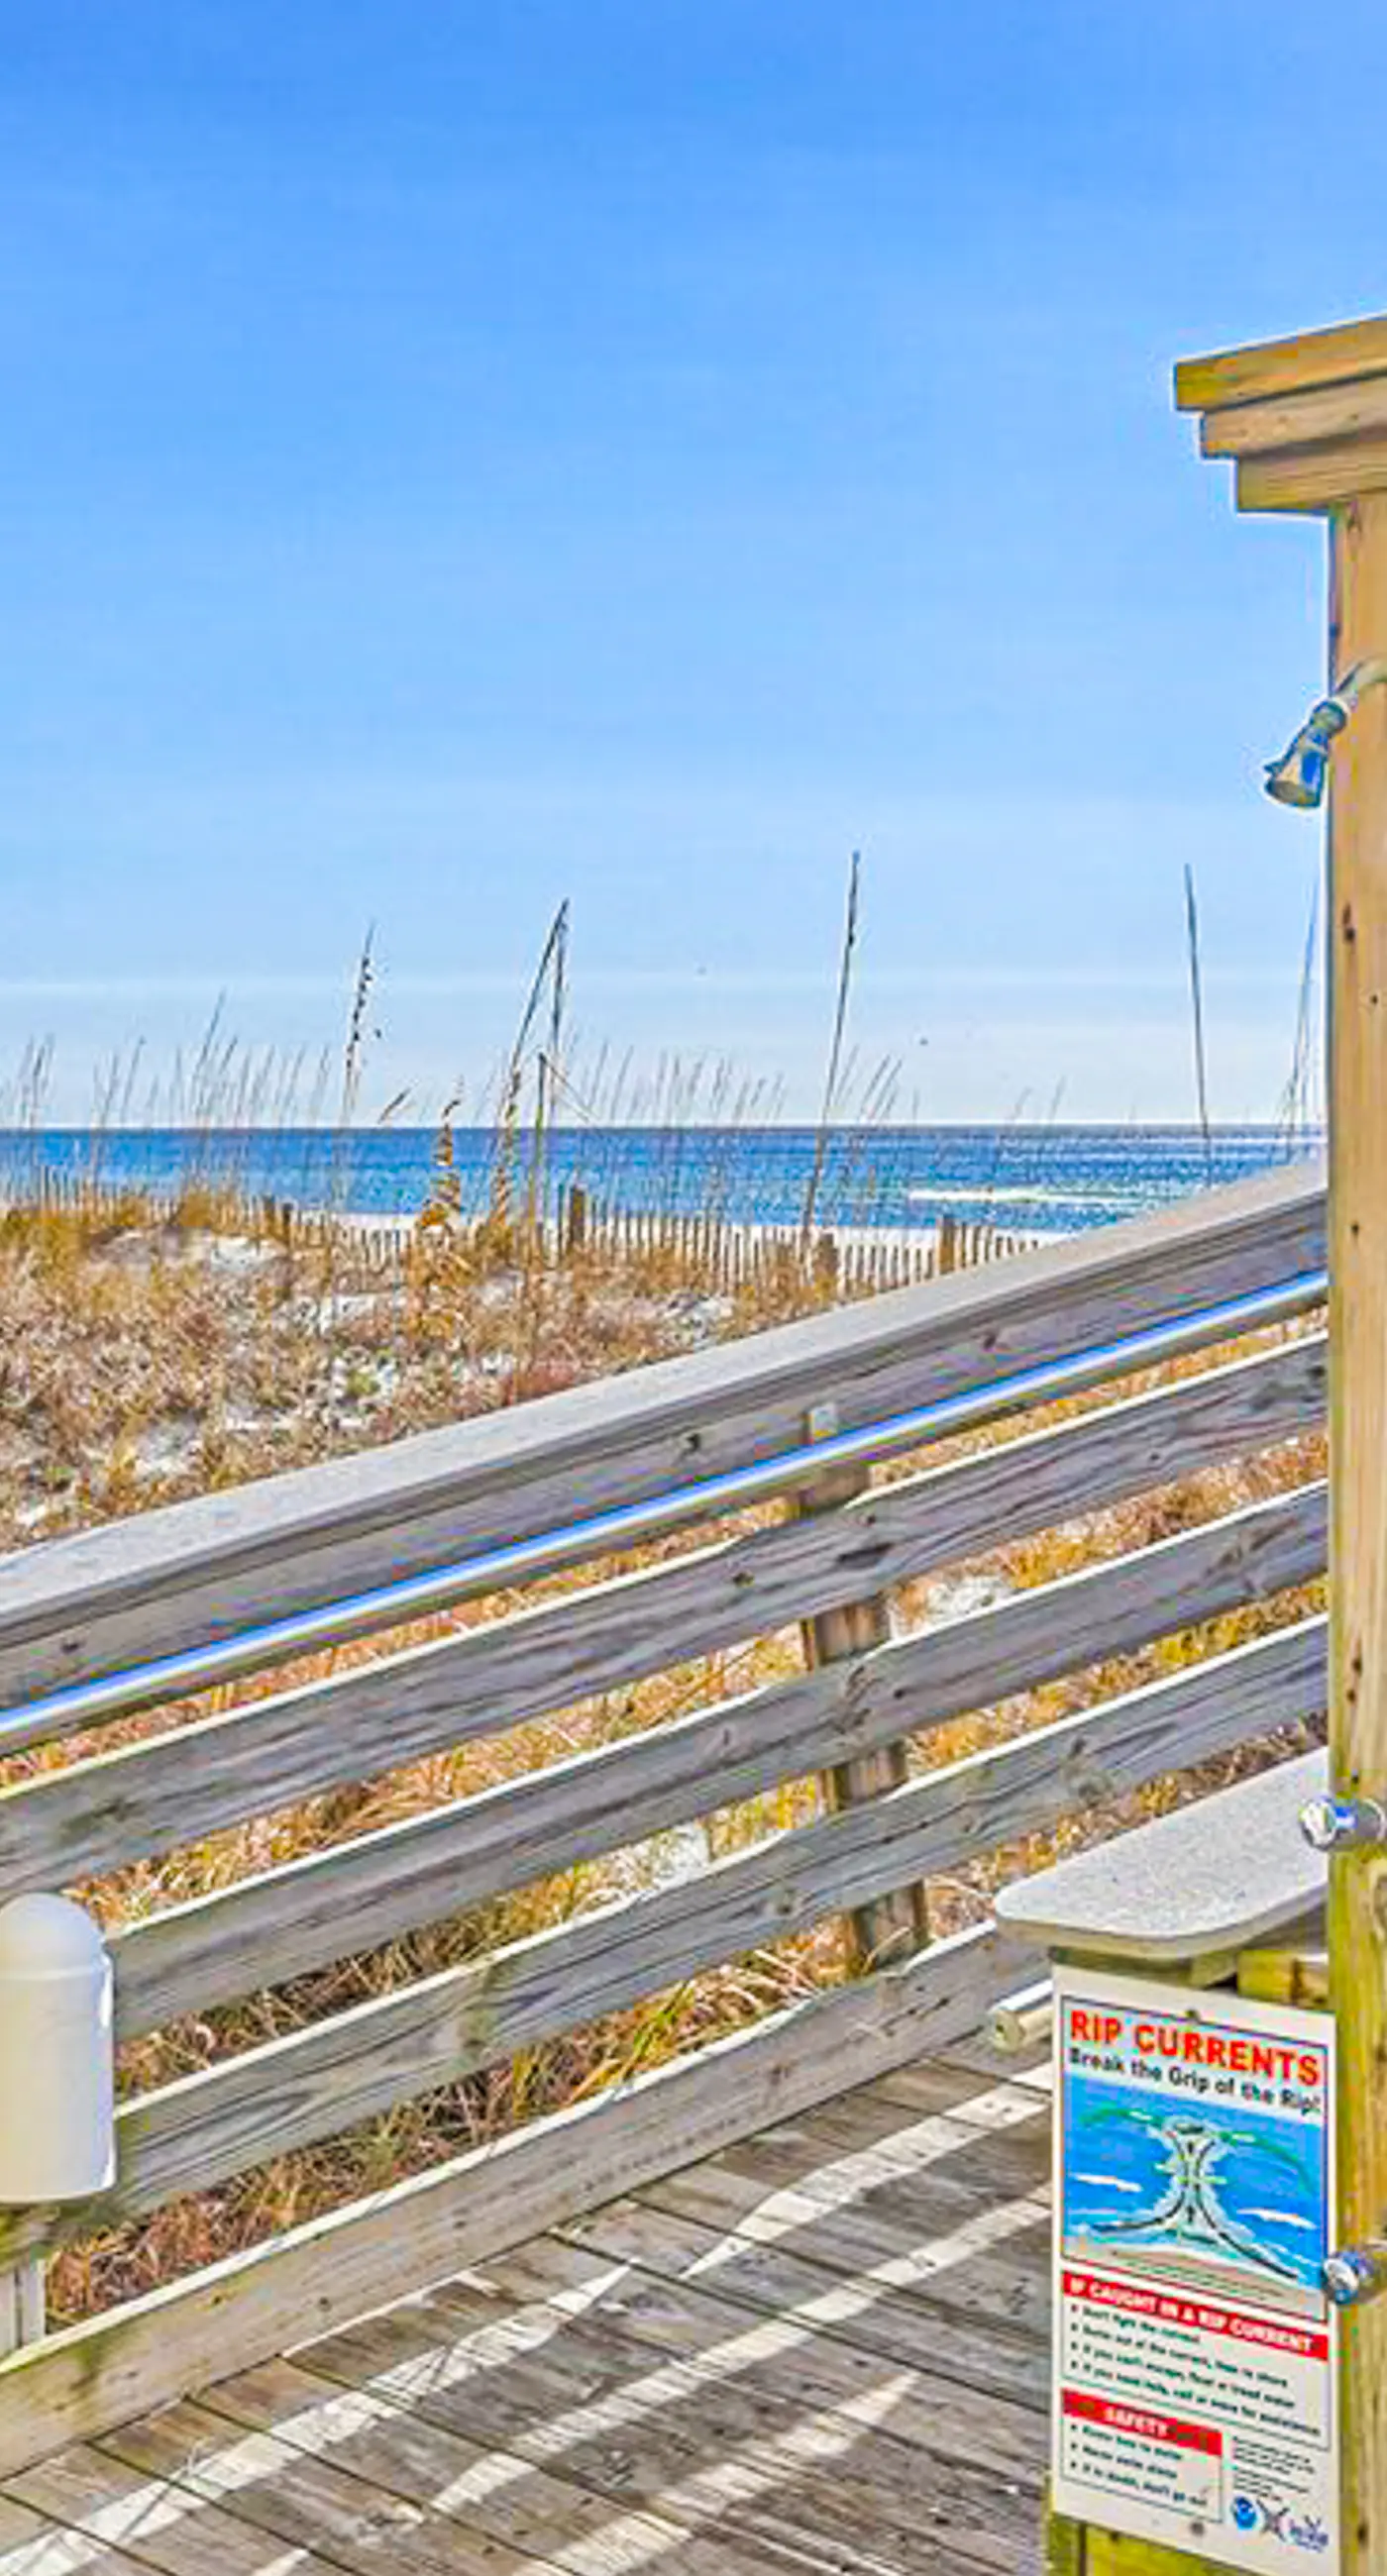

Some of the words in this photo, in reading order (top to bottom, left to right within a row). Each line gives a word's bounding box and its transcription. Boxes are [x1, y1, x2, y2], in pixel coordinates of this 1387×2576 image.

[1070, 2047, 1125, 2075] Break
[1131, 2056, 1162, 2081] the
[1169, 2065, 1210, 2093] Grip
[1215, 2077, 1234, 2096] of
[1240, 2080, 1275, 2105] the
[1071, 2009, 1120, 2044] RIP
[1134, 2023, 1320, 2086] CURRENTS
[1069, 2277, 1086, 2294] IF
[1089, 2281, 1156, 2313] CAUGHT
[1159, 2299, 1178, 2317] IN
[1182, 2304, 1195, 2322] A
[1198, 2310, 1227, 2328] RIP
[1229, 2318, 1313, 2351] CURRENT
[1104, 2407, 1168, 2437] SAFETY
